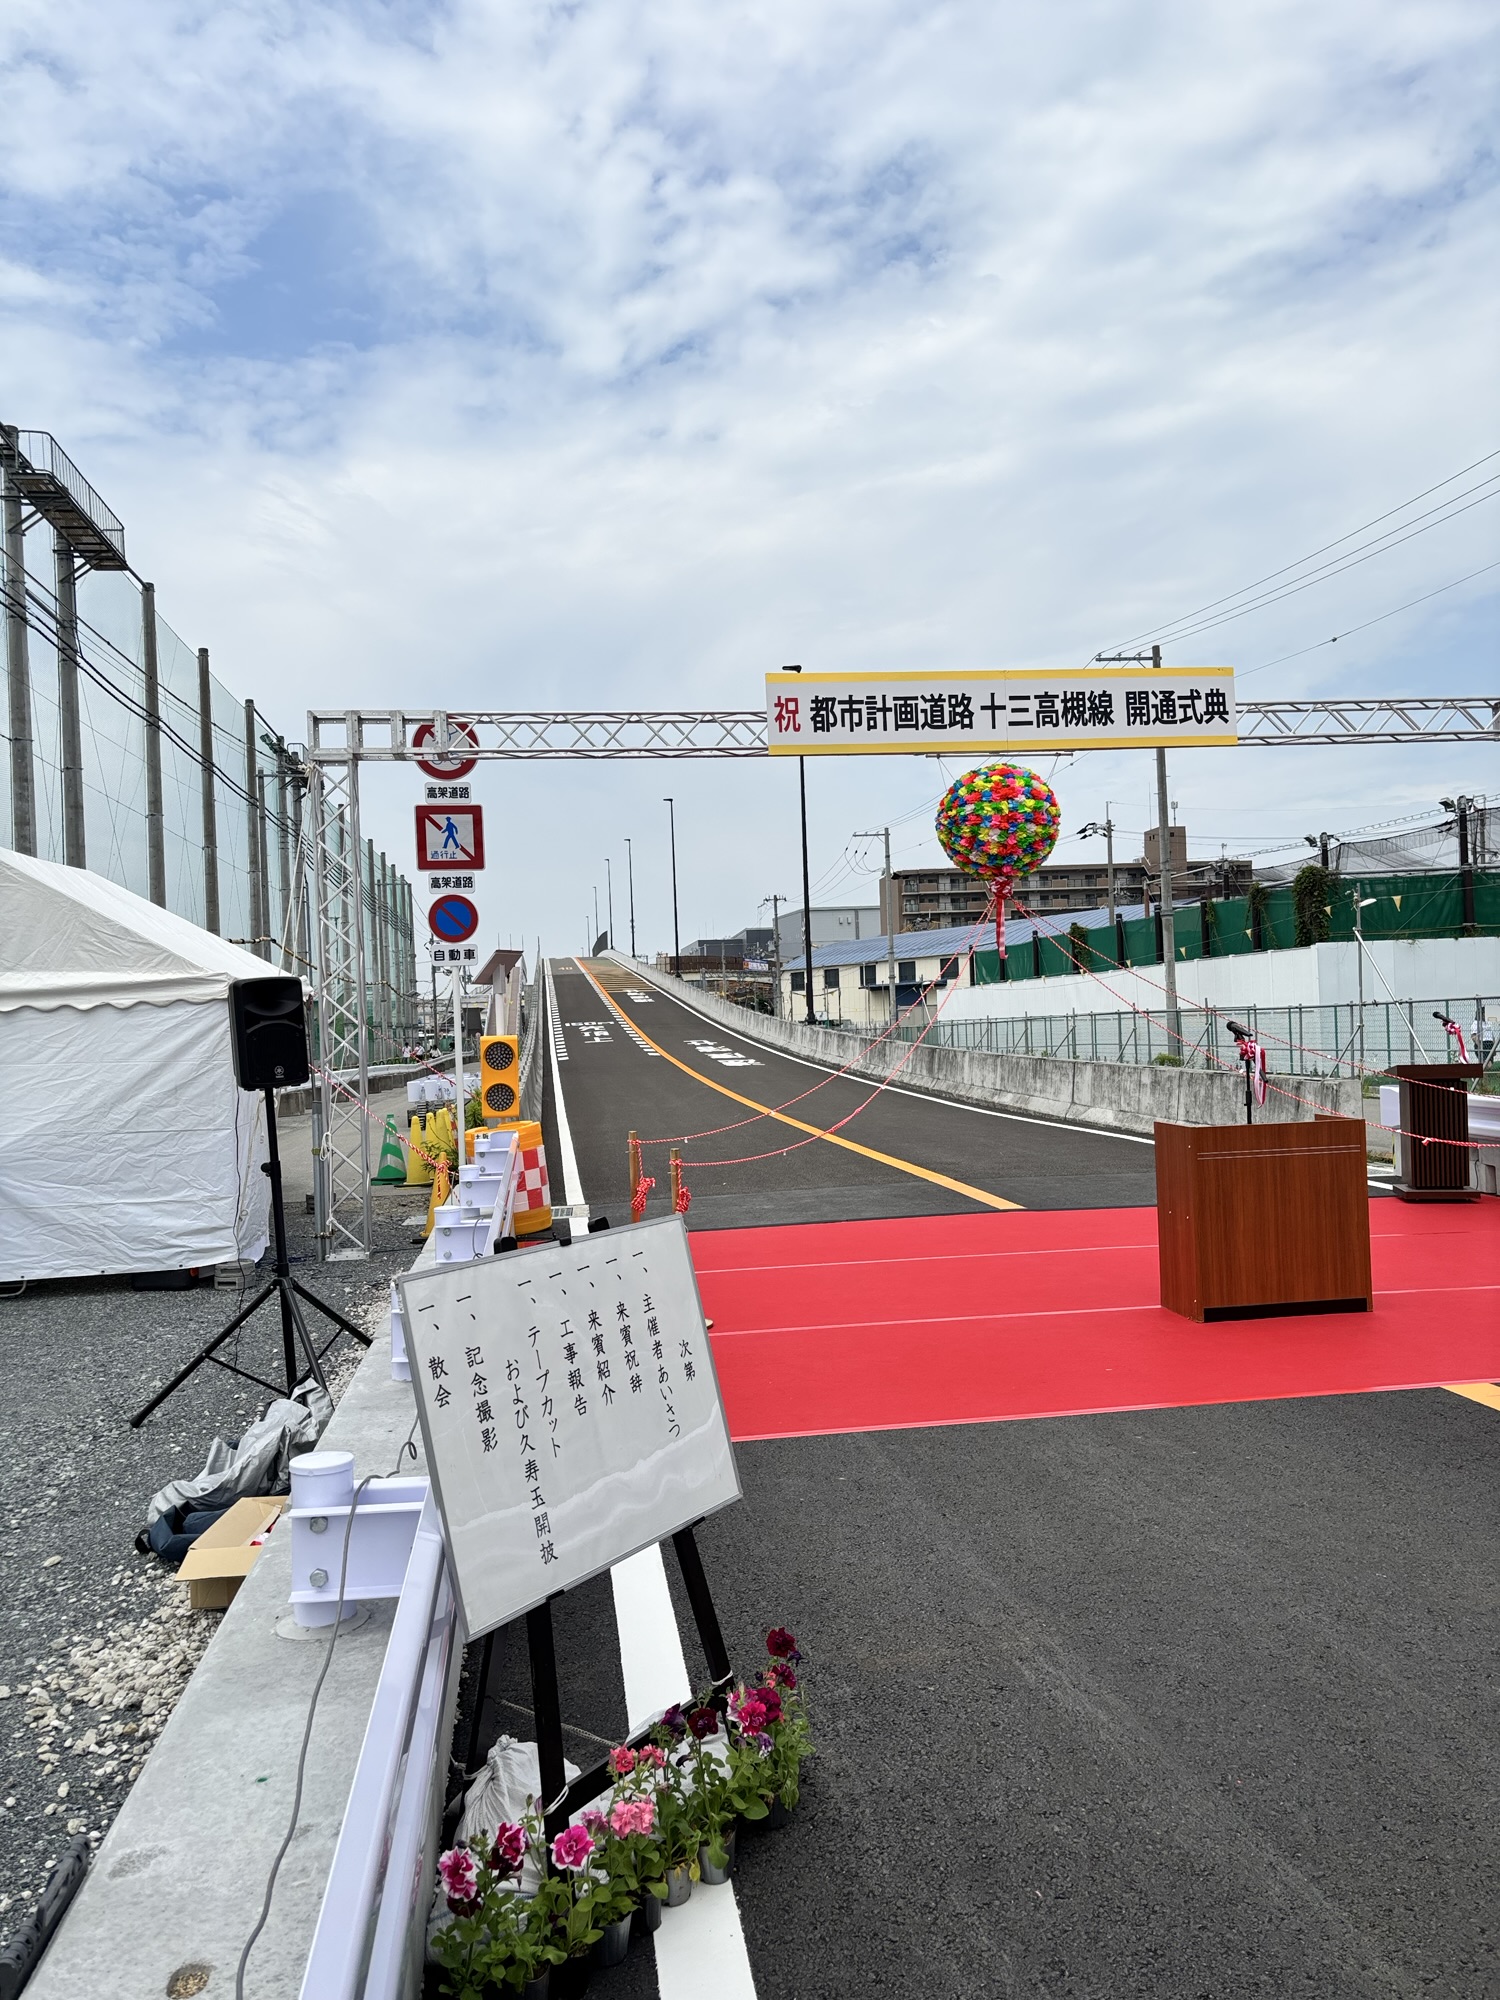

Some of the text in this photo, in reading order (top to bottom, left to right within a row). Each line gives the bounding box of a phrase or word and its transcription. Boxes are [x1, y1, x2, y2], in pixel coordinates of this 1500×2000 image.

[774, 695, 801, 733] 祝
[1125, 687, 1230, 726] 開通式典
[426, 786, 470, 799] 高架道路
[430, 850, 458, 859] 通行止
[430, 876, 473, 889] 高架道路
[433, 948, 476, 961] 自動車
[678, 1339, 696, 1381] 次第
